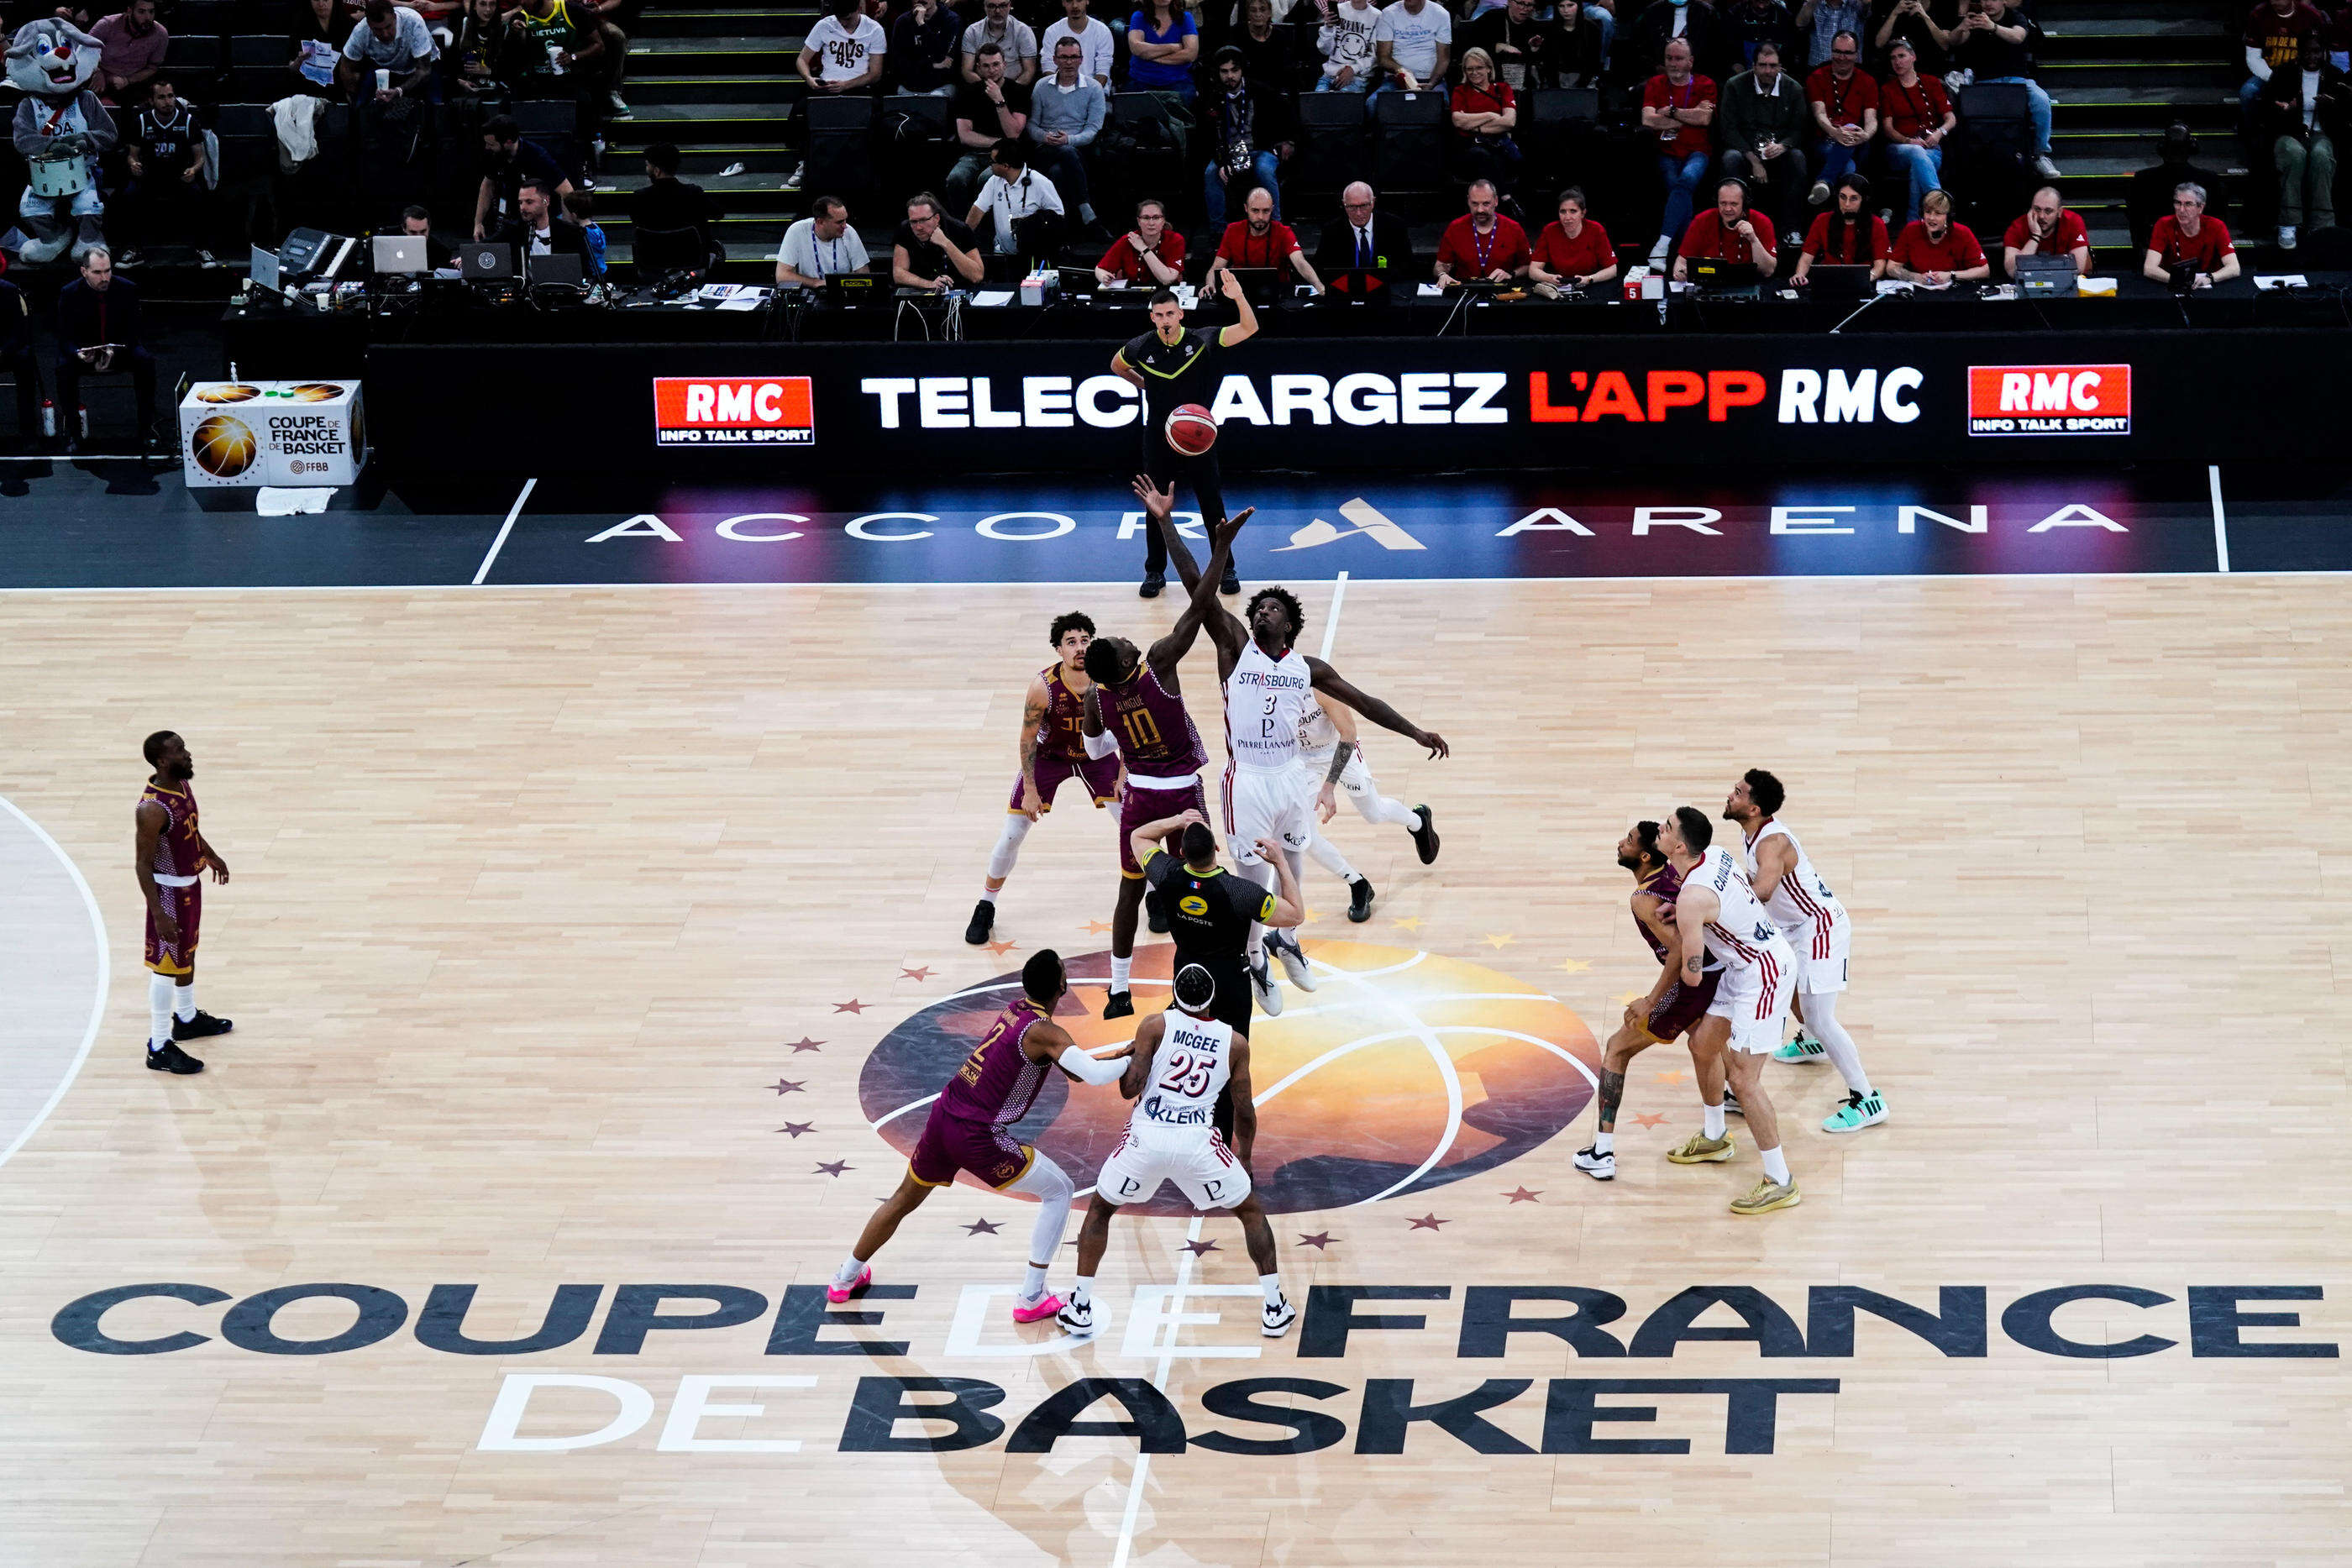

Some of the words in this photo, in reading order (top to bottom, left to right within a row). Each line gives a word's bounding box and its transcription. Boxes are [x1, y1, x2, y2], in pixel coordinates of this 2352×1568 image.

[531, 28, 566, 36] LIETUVA
[829, 40, 864, 58] CAVS
[1629, 287, 1636, 299] 5
[861, 373, 1508, 428] TELECARGEZ
[1530, 371, 1767, 422] L'APP
[1777, 366, 1924, 423] RMC
[2000, 371, 2102, 411] RMC
[686, 384, 784, 422] RMC
[269, 417, 325, 429] COUPE
[328, 420, 340, 428] DE
[1972, 419, 2014, 432] INFO
[2018, 418, 2063, 430] TALK
[2066, 417, 2128, 430] SPORT
[271, 429, 339, 442] FRANCE
[660, 430, 701, 442] INFO
[705, 430, 749, 442] TALK
[752, 429, 811, 442] SPORT
[269, 442, 281, 451] DE
[283, 442, 345, 454] BASKET
[584, 511, 1208, 543] ACCOR
[1494, 504, 2129, 537] ARENA
[1239, 671, 1305, 690] STRASBOURG
[1263, 693, 1277, 715] 3
[1121, 707, 1162, 749] 10
[1188, 916, 1214, 927] POSTE
[973, 1021, 1006, 1063] 2
[1173, 1030, 1221, 1053] MCGEE
[1158, 1048, 1217, 1099] 25
[1156, 1109, 1205, 1125] KLEIN
[52, 1282, 918, 1356] COUPE
[943, 1283, 1266, 1358] DE
[1297, 1284, 2340, 1358] FRANCE
[476, 1374, 819, 1453] DE
[838, 1377, 1840, 1455] BASKET
